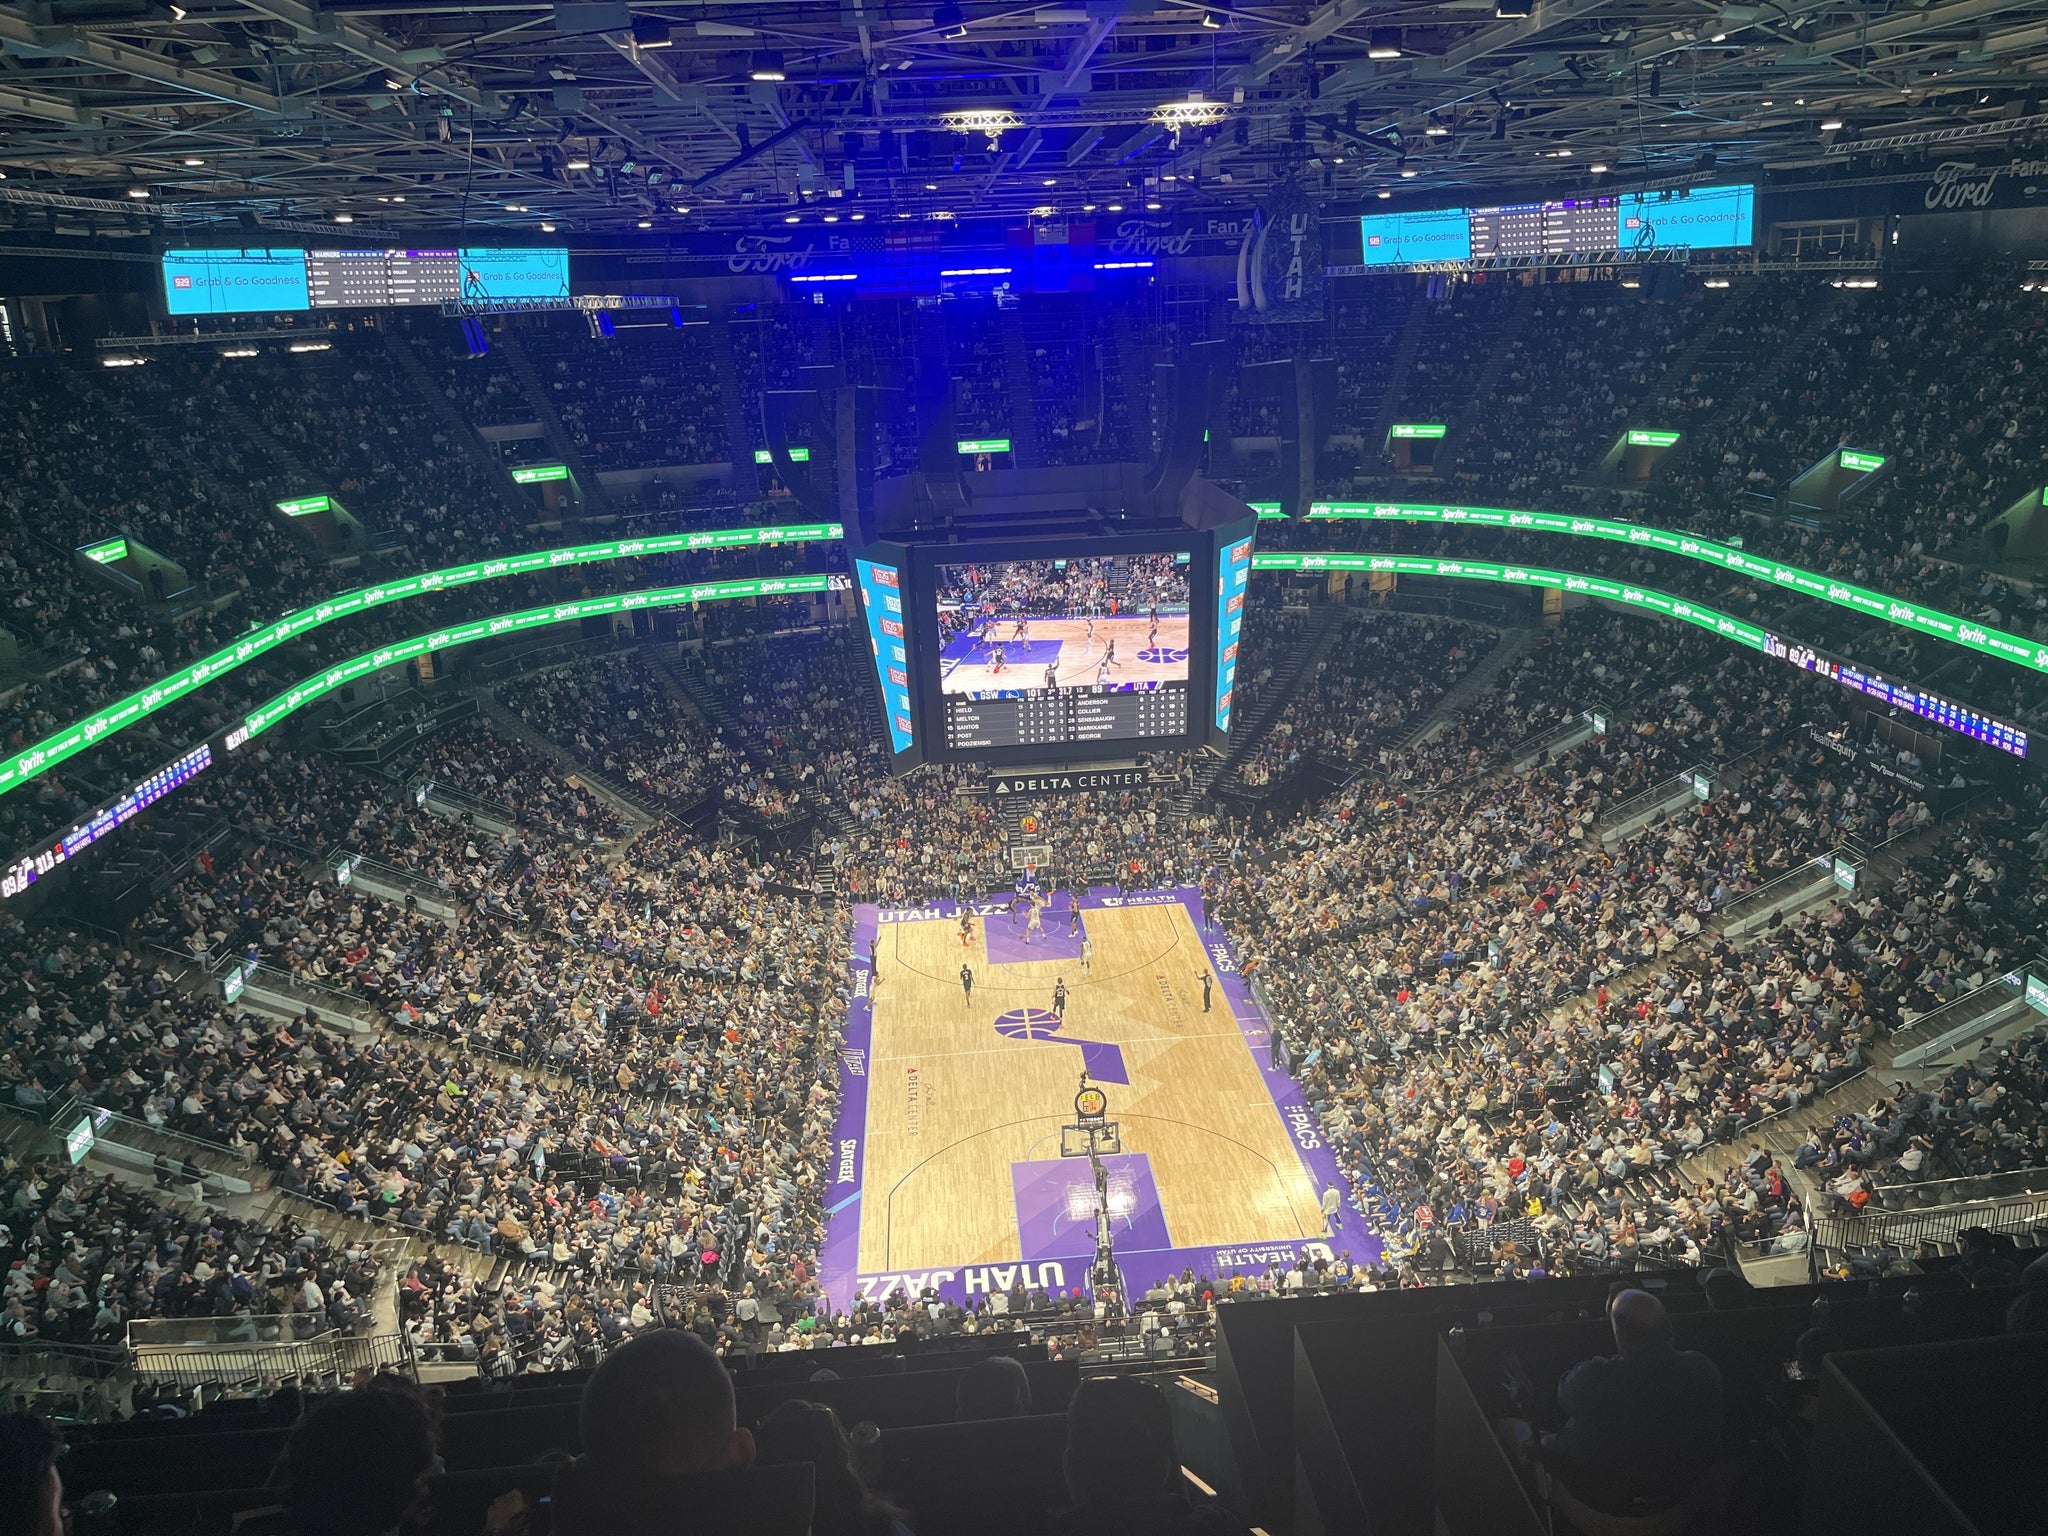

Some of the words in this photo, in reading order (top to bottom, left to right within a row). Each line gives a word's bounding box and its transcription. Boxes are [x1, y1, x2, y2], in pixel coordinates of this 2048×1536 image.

[1924, 161, 1999, 209] Ford
[1680, 216, 1694, 224] Go
[1697, 212, 1746, 223] Goodness
[1208, 220, 1238, 234] Fan
[829, 235, 850, 250] Fa
[1109, 220, 1193, 256] Ford
[1384, 236, 1402, 244] Grab
[1412, 235, 1422, 243] Go
[1425, 232, 1464, 242] Goodness
[728, 235, 815, 273] Ford
[1285, 213, 1308, 299] UTAH
[196, 277, 222, 287] Grab
[224, 277, 232, 286] &
[234, 276, 248, 286] Go
[252, 276, 300, 285] Goodness
[527, 272, 563, 280] Goodness
[1372, 504, 1400, 518] Sprite
[1442, 508, 1468, 520] Sprite
[1508, 514, 1534, 526] Sprite
[1570, 520, 1596, 534] Sprite
[688, 534, 716, 548] Sprite
[758, 528, 784, 542] Sprite
[1628, 528, 1652, 542] Sprite
[618, 542, 644, 556] Sprite
[548, 550, 576, 564] Sprite
[1300, 556, 1328, 568] Sprite
[1368, 557, 1396, 570] Sprite
[482, 562, 508, 576] Sprite
[1436, 562, 1462, 574] Sprite
[1502, 568, 1528, 582] Sprite
[420, 574, 444, 590] Sprite
[760, 580, 786, 594] Sprite
[1564, 576, 1588, 590] Sprite
[690, 586, 717, 600] Sprite
[1828, 584, 1852, 602] Sprite
[620, 594, 648, 608] Sprite
[554, 606, 580, 620] Sprite
[1888, 602, 1914, 622] Sprite
[488, 618, 514, 634] Sprite
[1956, 624, 1987, 645] Sprite
[1775, 643, 1786, 658] 101
[1789, 648, 1800, 664] 89
[1059, 687, 1072, 696] 31.7
[1092, 685, 1102, 693] 89
[1133, 682, 1149, 691] UTA
[980, 690, 998, 700] GSW
[84, 718, 108, 742] Sprite
[1810, 728, 1857, 762] HealthEquity
[18, 750, 46, 776] Sprite
[1014, 778, 1072, 792] DELTA
[1078, 773, 1143, 787] CENTER
[2, 876, 17, 897] 89
[878, 908, 940, 923] UTAH
[946, 903, 1009, 918] JAZZ
[1212, 946, 1236, 972] PACS
[854, 969, 869, 998] SEATGEEK
[1159, 980, 1174, 1002] DELTA
[908, 1075, 918, 1102] DELTA
[907, 1104, 918, 1136] CENTER
[1287, 1111, 1321, 1150] PACS
[837, 1139, 857, 1184] SEATGEEK
[1218, 1251, 1296, 1267] HEALTH
[964, 1261, 1065, 1295] UTAH
[857, 1270, 955, 1302] JAZZ
